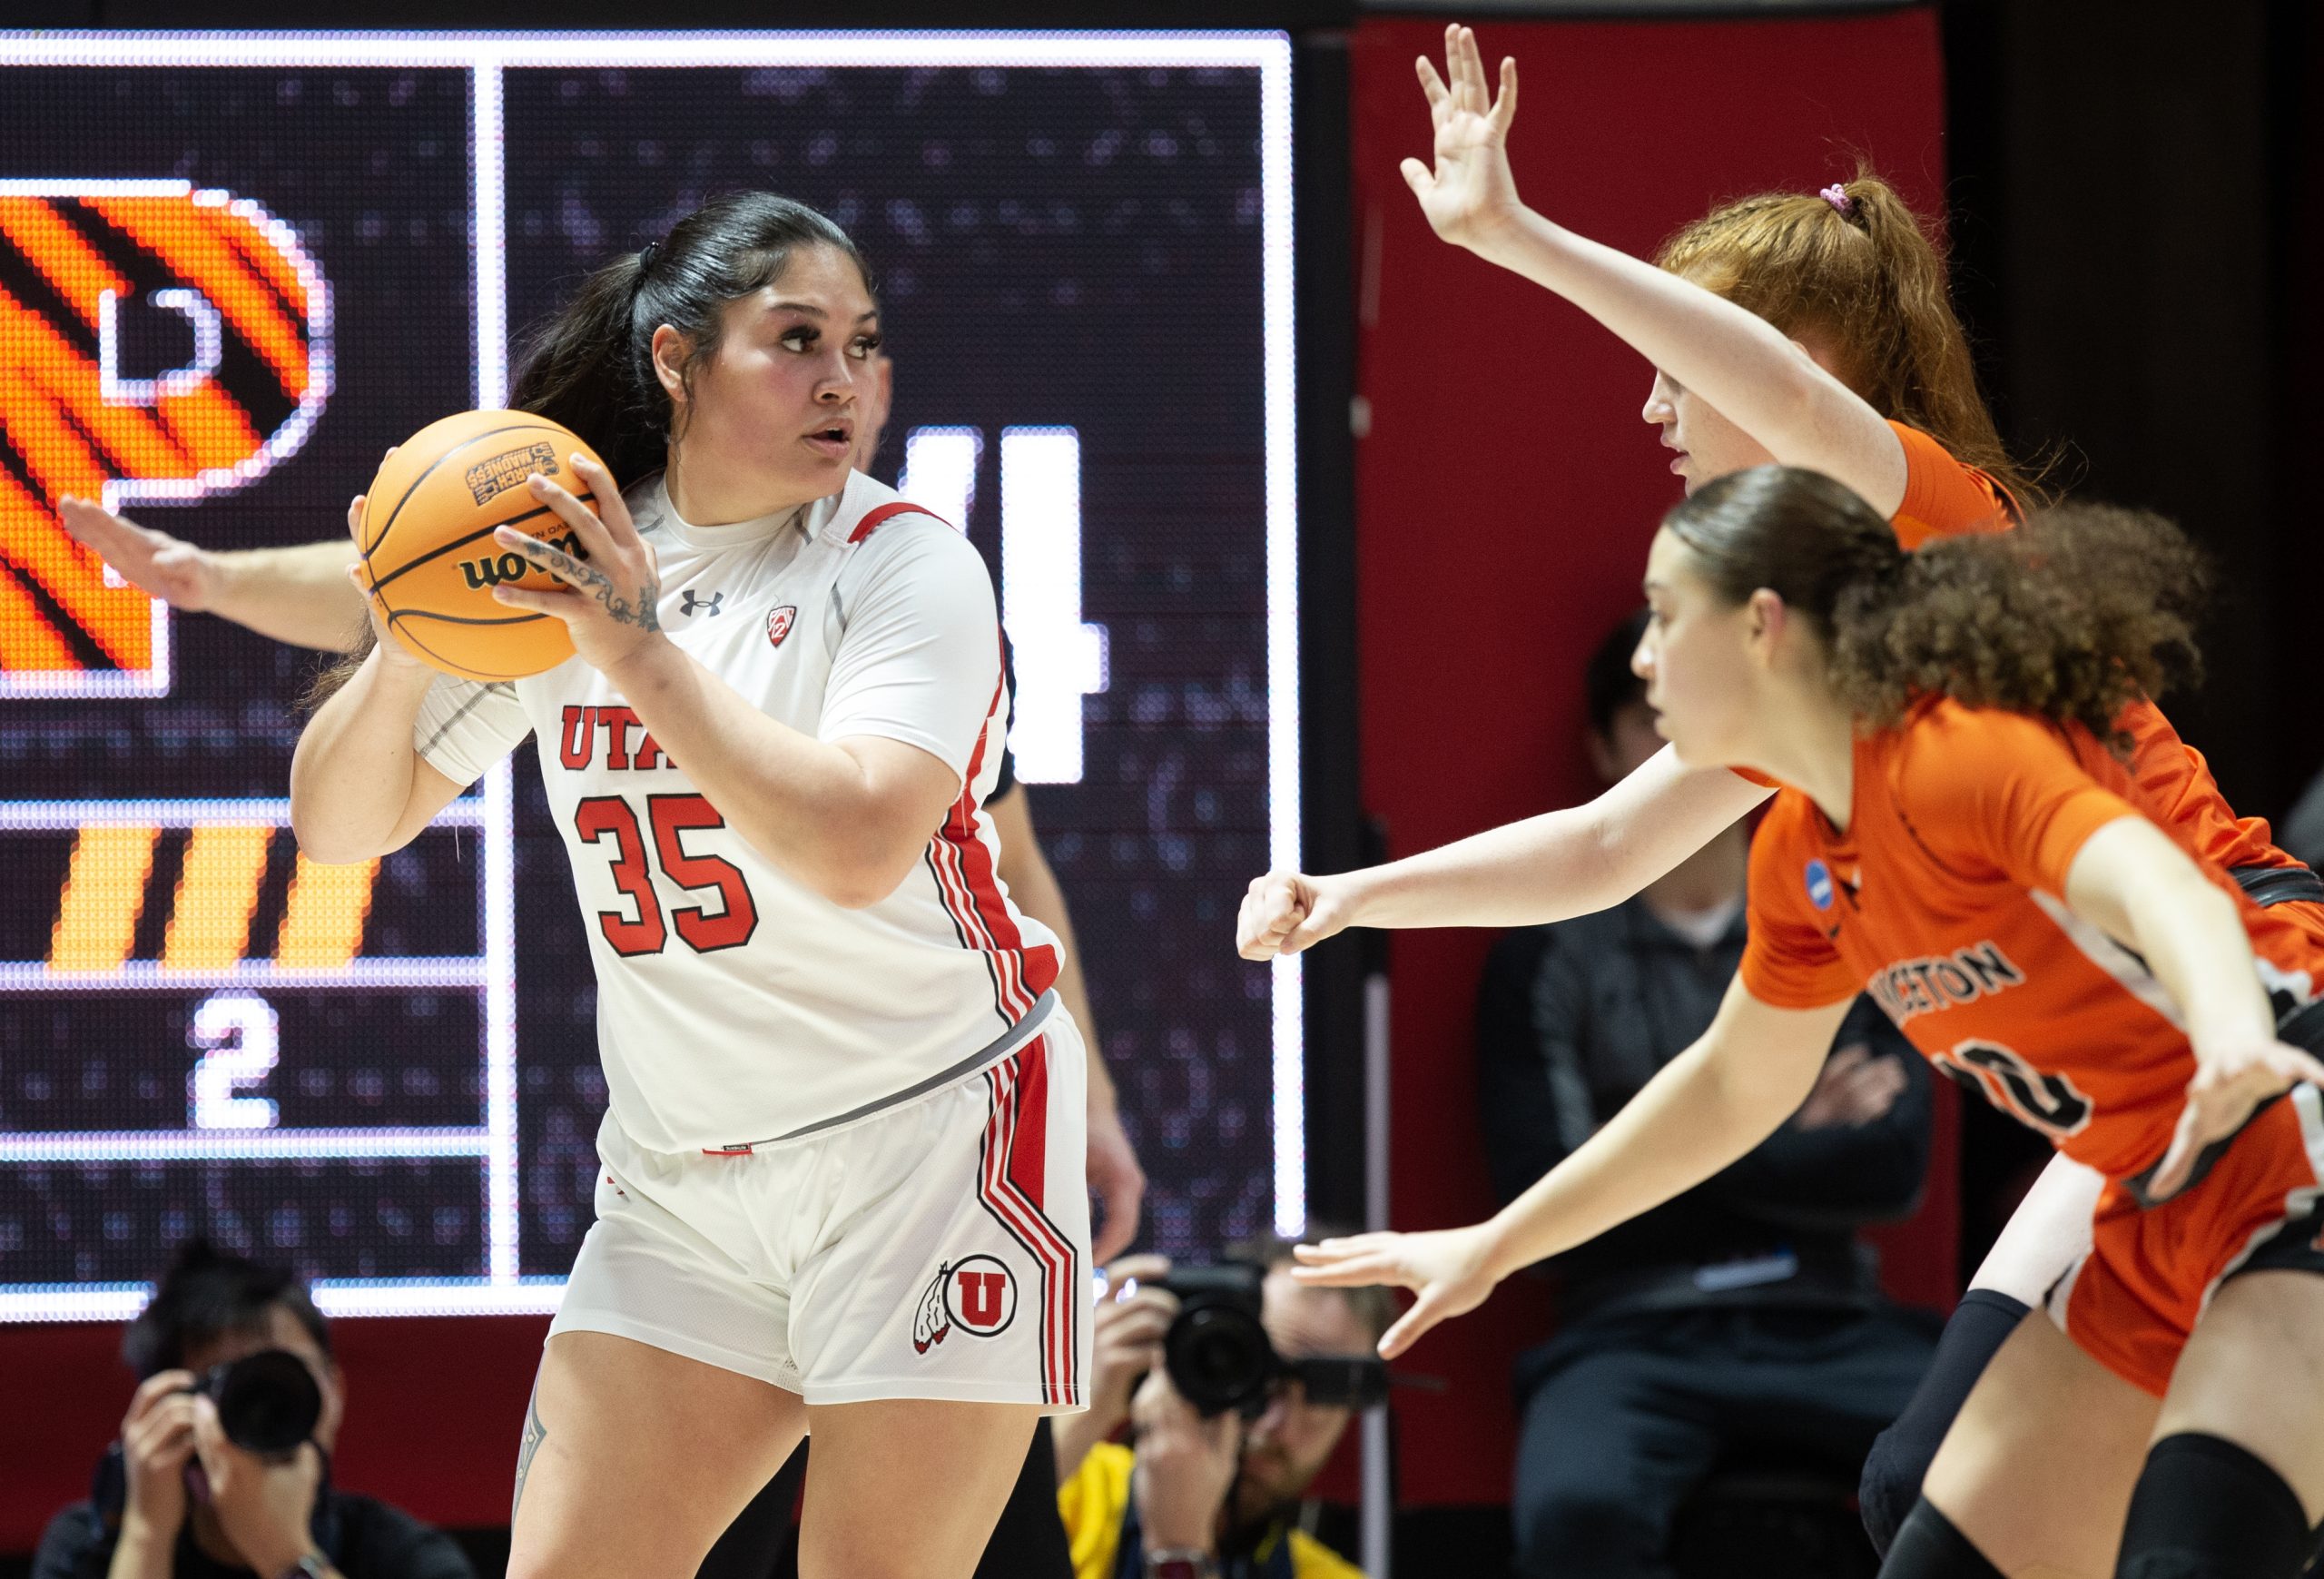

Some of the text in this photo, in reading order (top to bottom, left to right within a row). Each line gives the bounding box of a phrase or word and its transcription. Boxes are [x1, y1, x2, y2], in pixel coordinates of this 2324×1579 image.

[466, 447, 536, 491] MADNESS
[771, 622, 786, 639] 12
[559, 705, 679, 771] UTA
[574, 793, 760, 959] 35
[187, 988, 279, 1129] 2
[958, 1271, 1006, 1327] U
